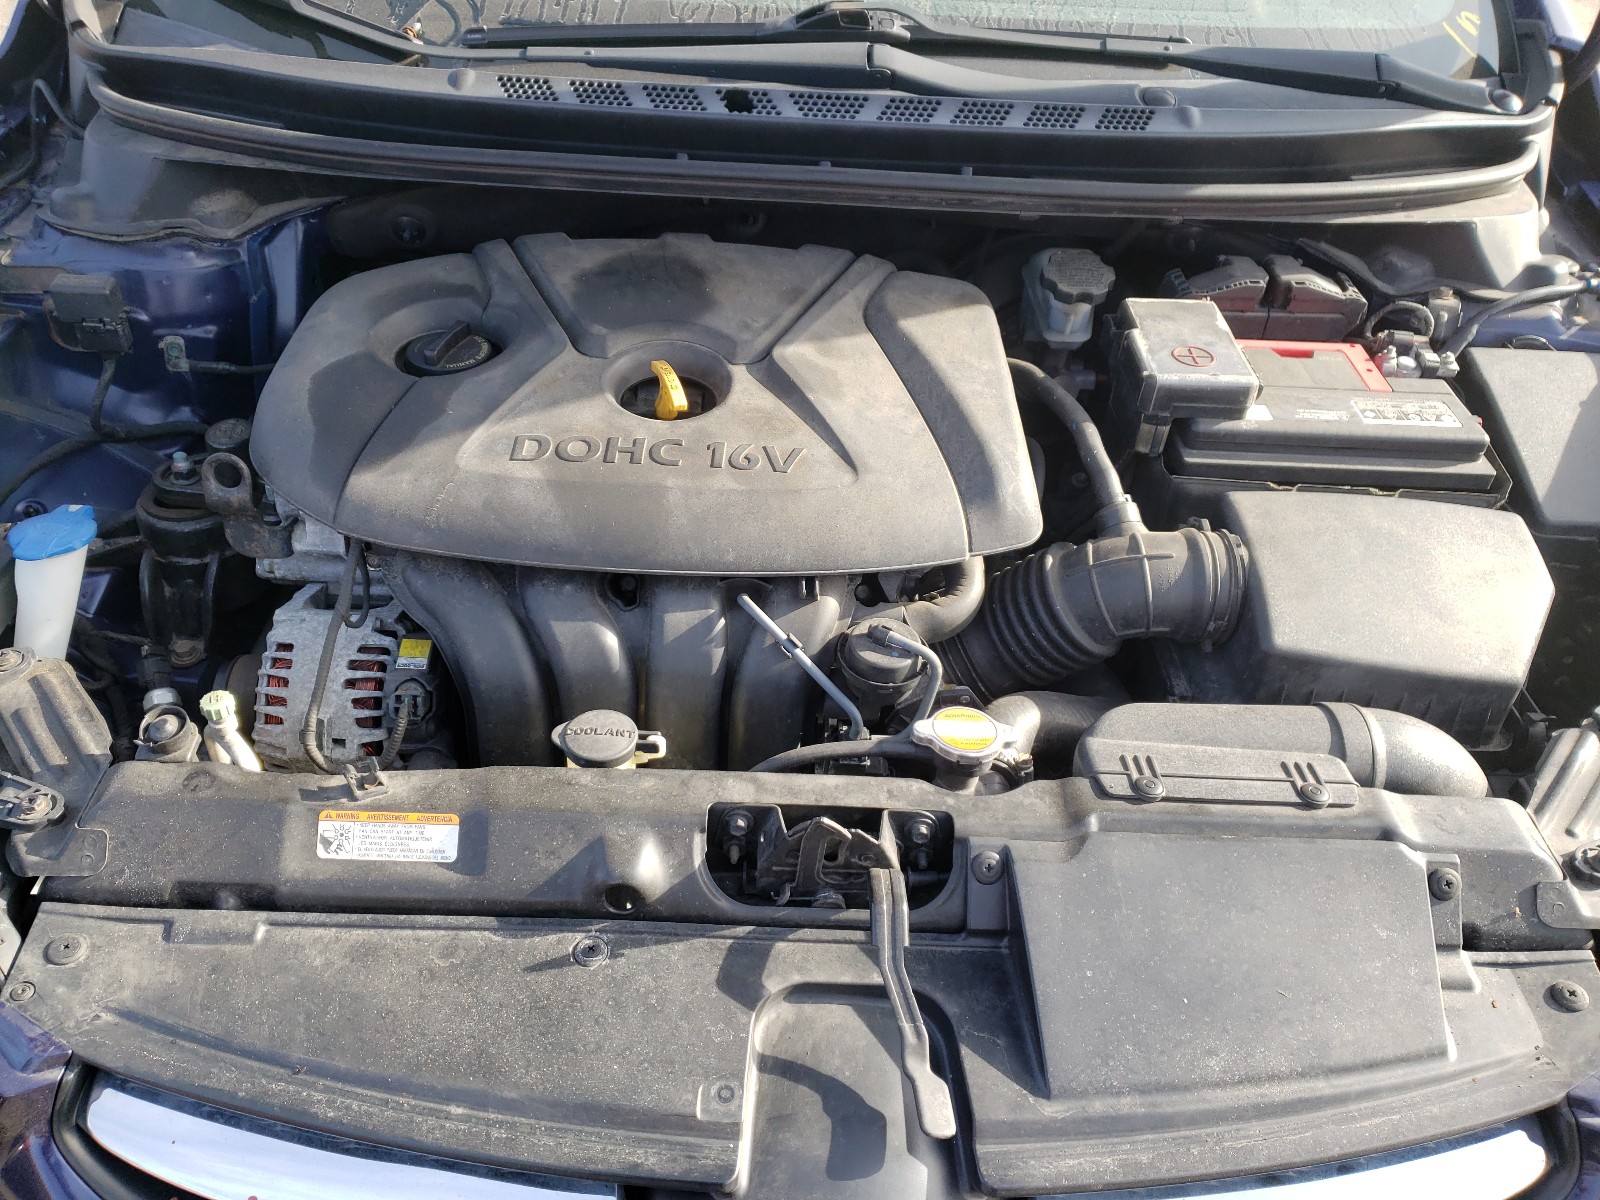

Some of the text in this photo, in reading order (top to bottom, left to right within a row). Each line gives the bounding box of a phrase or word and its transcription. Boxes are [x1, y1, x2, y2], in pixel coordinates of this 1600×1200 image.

[509, 434, 806, 474] DOHC 16V
[565, 727, 636, 739] COOLANT
[335, 812, 453, 823] WARNING AVERTISSEMENT ADVERTENCIA
